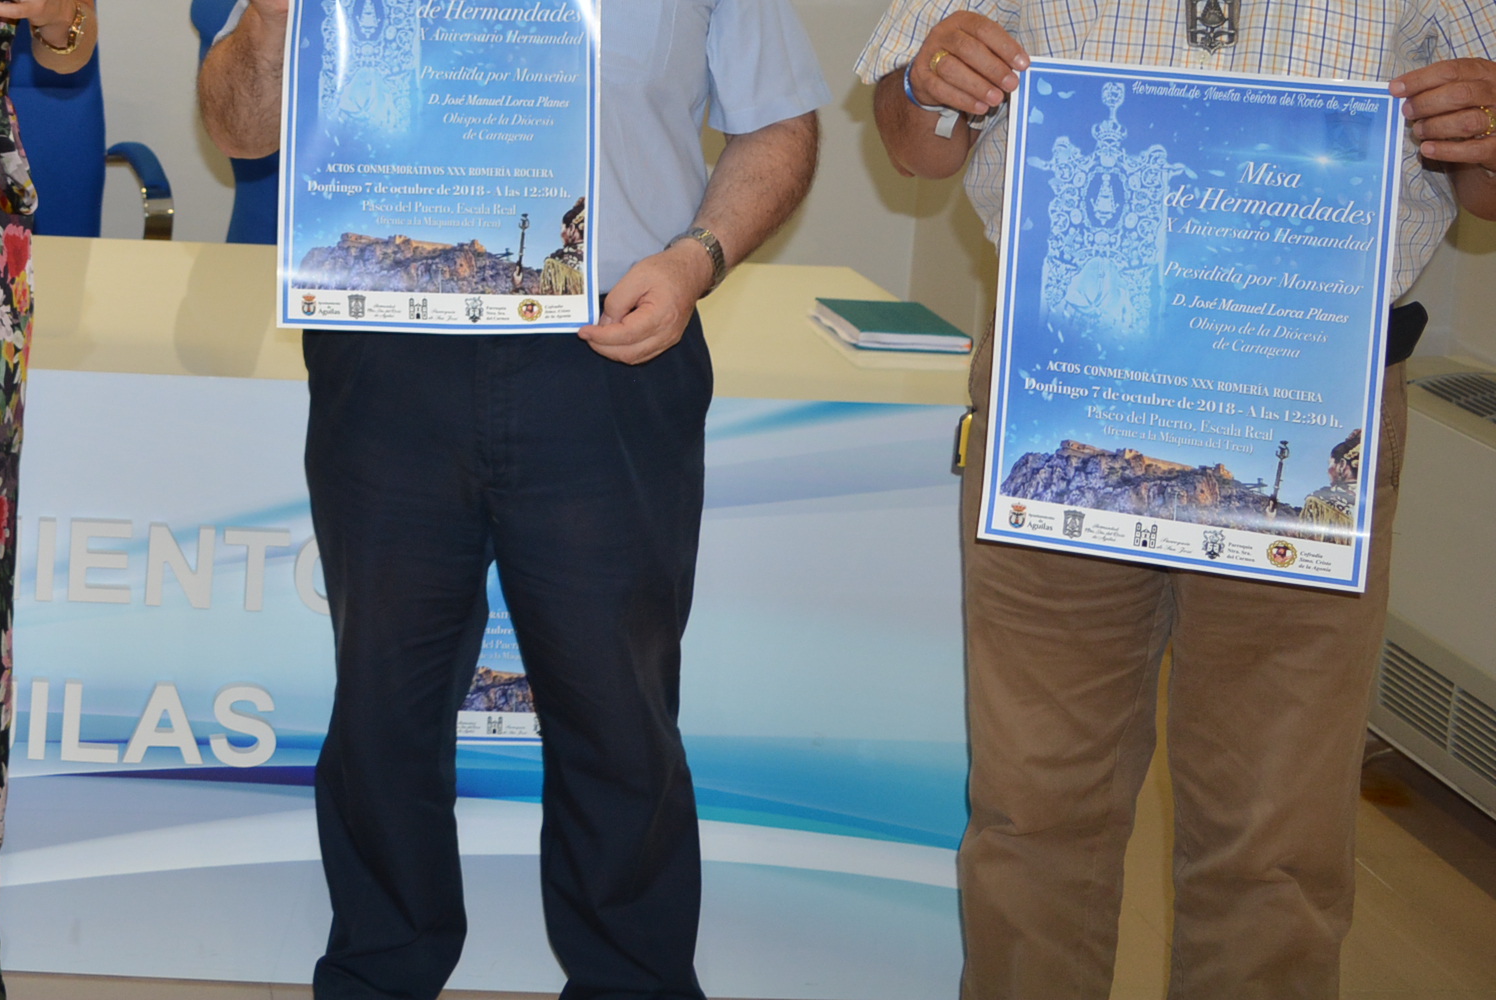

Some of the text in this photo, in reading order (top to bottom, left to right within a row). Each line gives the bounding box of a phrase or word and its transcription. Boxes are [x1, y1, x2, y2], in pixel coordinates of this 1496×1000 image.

[442, 0, 583, 26] Hermandades
[420, 65, 483, 80] Presidida
[513, 68, 579, 82] Monseñor
[1239, 161, 1300, 187] Misa
[1162, 182, 1374, 224] de Hermandades
[1178, 218, 1269, 240] Aniversario
[1273, 228, 1374, 251] Hermandad
[1163, 261, 1363, 294] Presidida por Monseñor
[1188, 295, 1218, 309] José
[1218, 298, 1267, 314] Manuel
[1266, 303, 1303, 318] Lorca
[1306, 307, 1349, 323] Planes
[1189, 317, 1328, 342] Obispo de la Diócesis
[1212, 336, 1300, 358] de Cartagena
[1046, 360, 1080, 373] ACTOS
[1083, 365, 1187, 386] CONMEMORATIVOS
[1191, 377, 1213, 389] XXX
[1273, 387, 1322, 402] ROCIERA
[1024, 376, 1088, 398] Domingo
[1091, 385, 1100, 397] 7
[1102, 387, 1119, 400] de
[1121, 393, 1175, 407] octubre
[1176, 396, 1194, 409] de
[1197, 399, 1235, 414] 2018
[1246, 404, 1259, 418] A
[1260, 406, 1279, 419] las
[1284, 410, 1326, 425] 12:30
